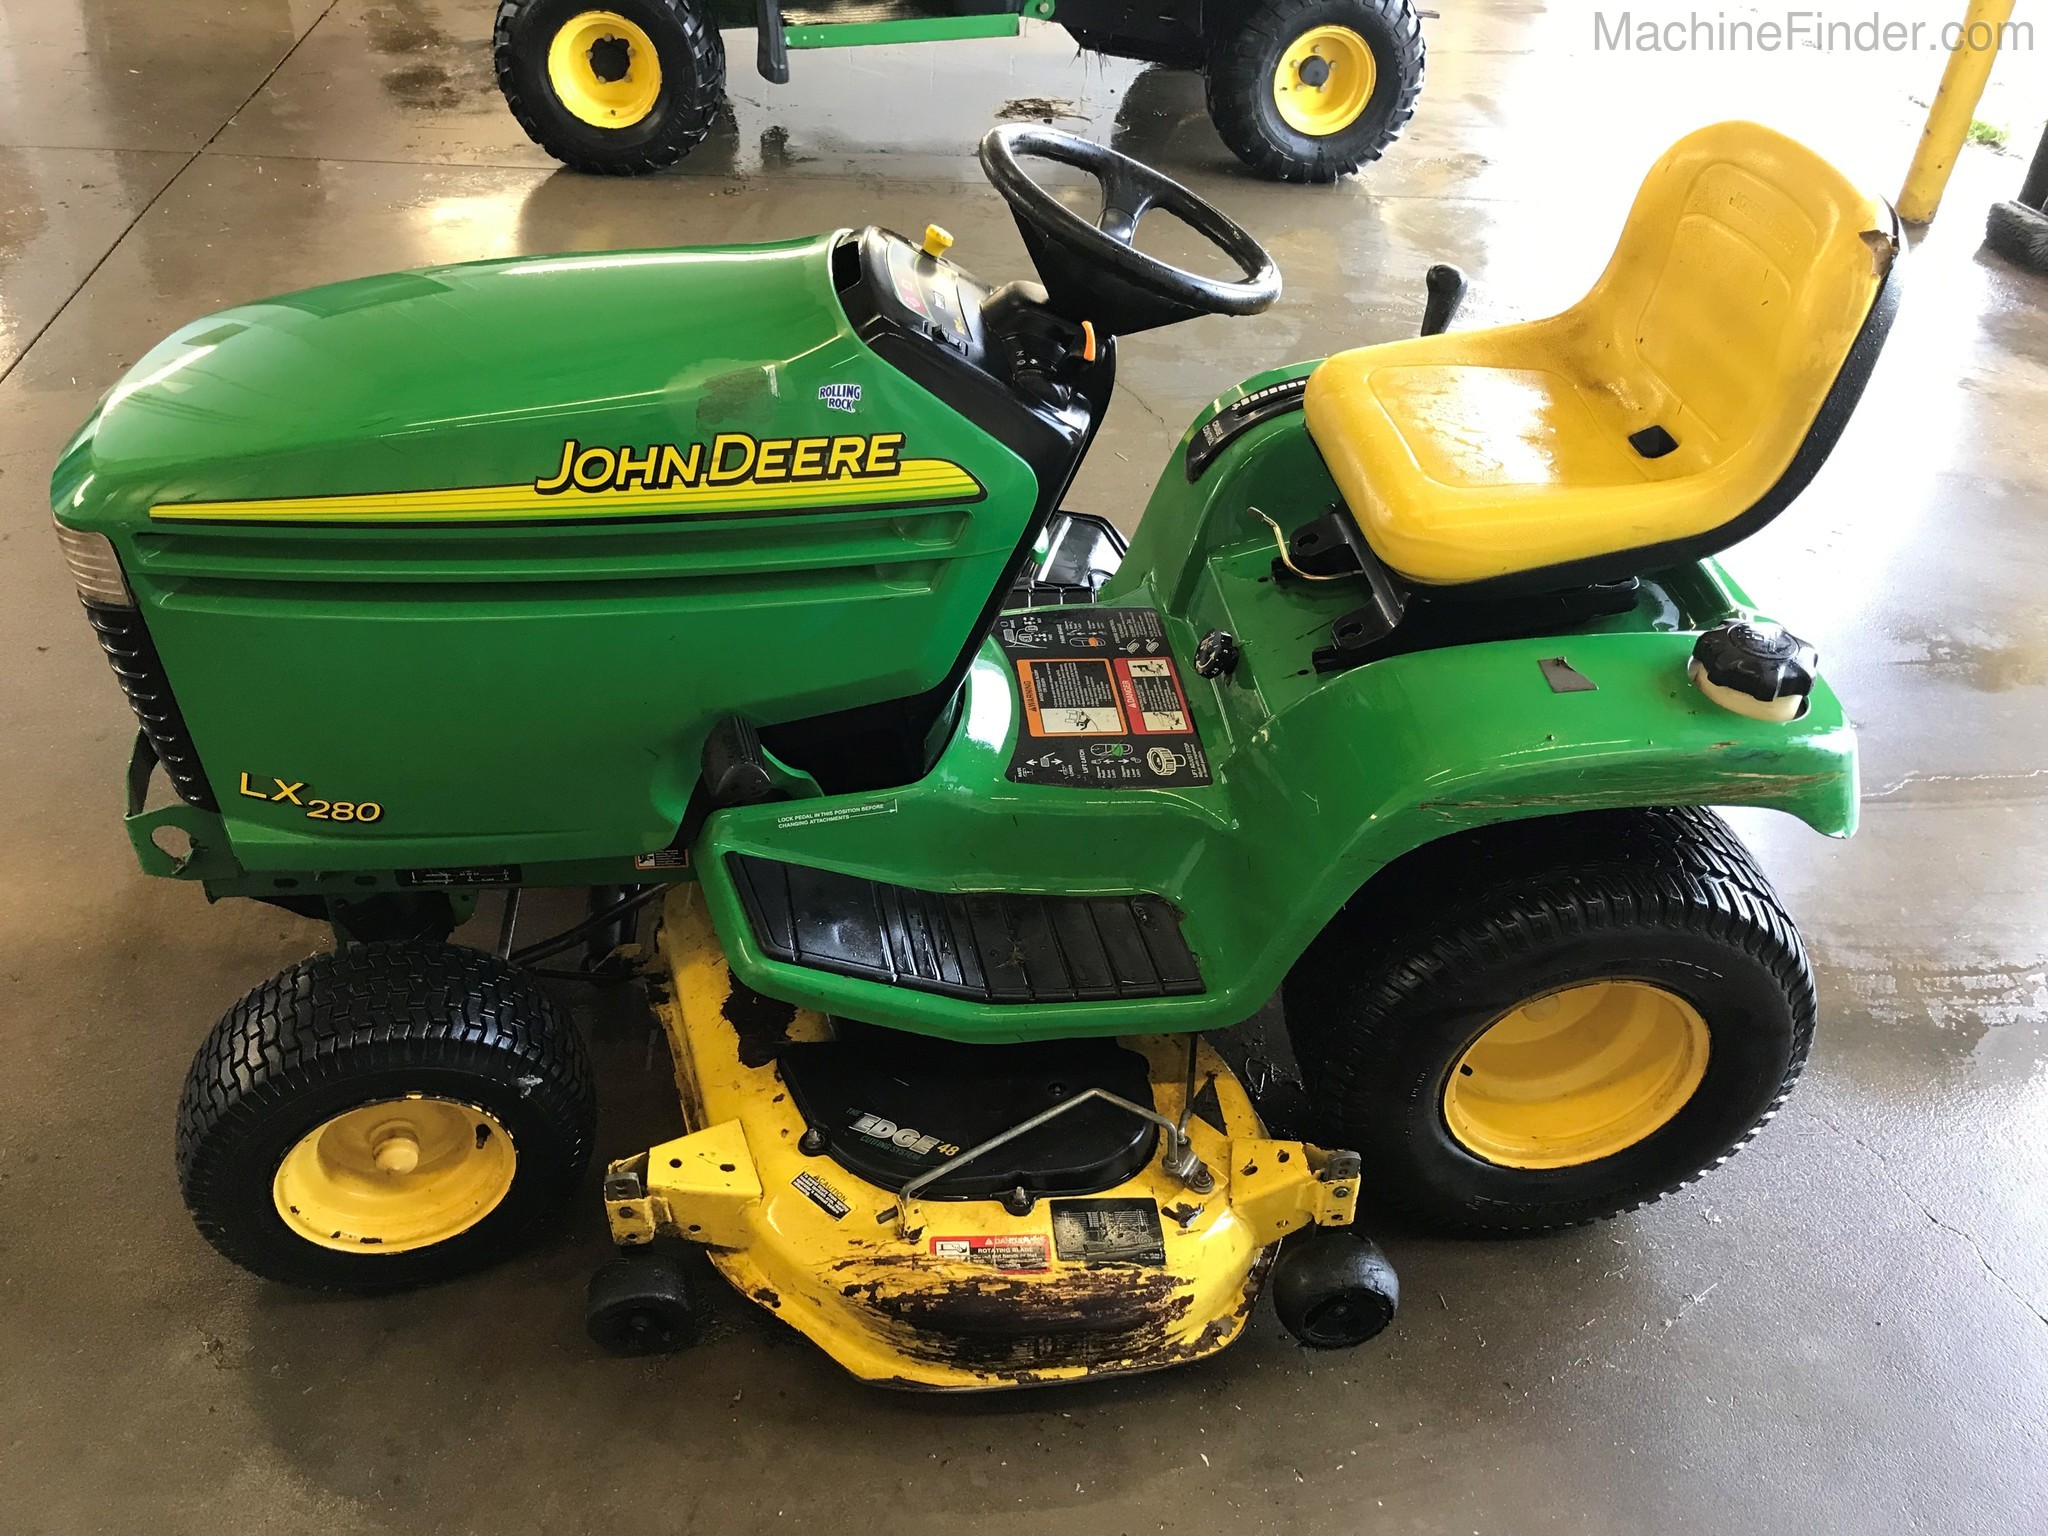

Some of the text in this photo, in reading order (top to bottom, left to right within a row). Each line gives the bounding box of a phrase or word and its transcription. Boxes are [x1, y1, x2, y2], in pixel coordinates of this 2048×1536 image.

[819, 384, 861, 400] ROLLING
[828, 398, 855, 412] ROCK
[535, 432, 906, 495] JOHN DEERE
[1024, 681, 1035, 707] WARNING
[1122, 680, 1135, 703] DANGER
[1079, 749, 1087, 763] LATCH
[1187, 754, 1195, 769] ADJUST
[834, 807, 860, 816] POSITION
[778, 814, 850, 828] CHANGING ATTACHMENTS
[848, 1113, 960, 1156] EDGE 48
[820, 1177, 848, 1202] CAUTION
